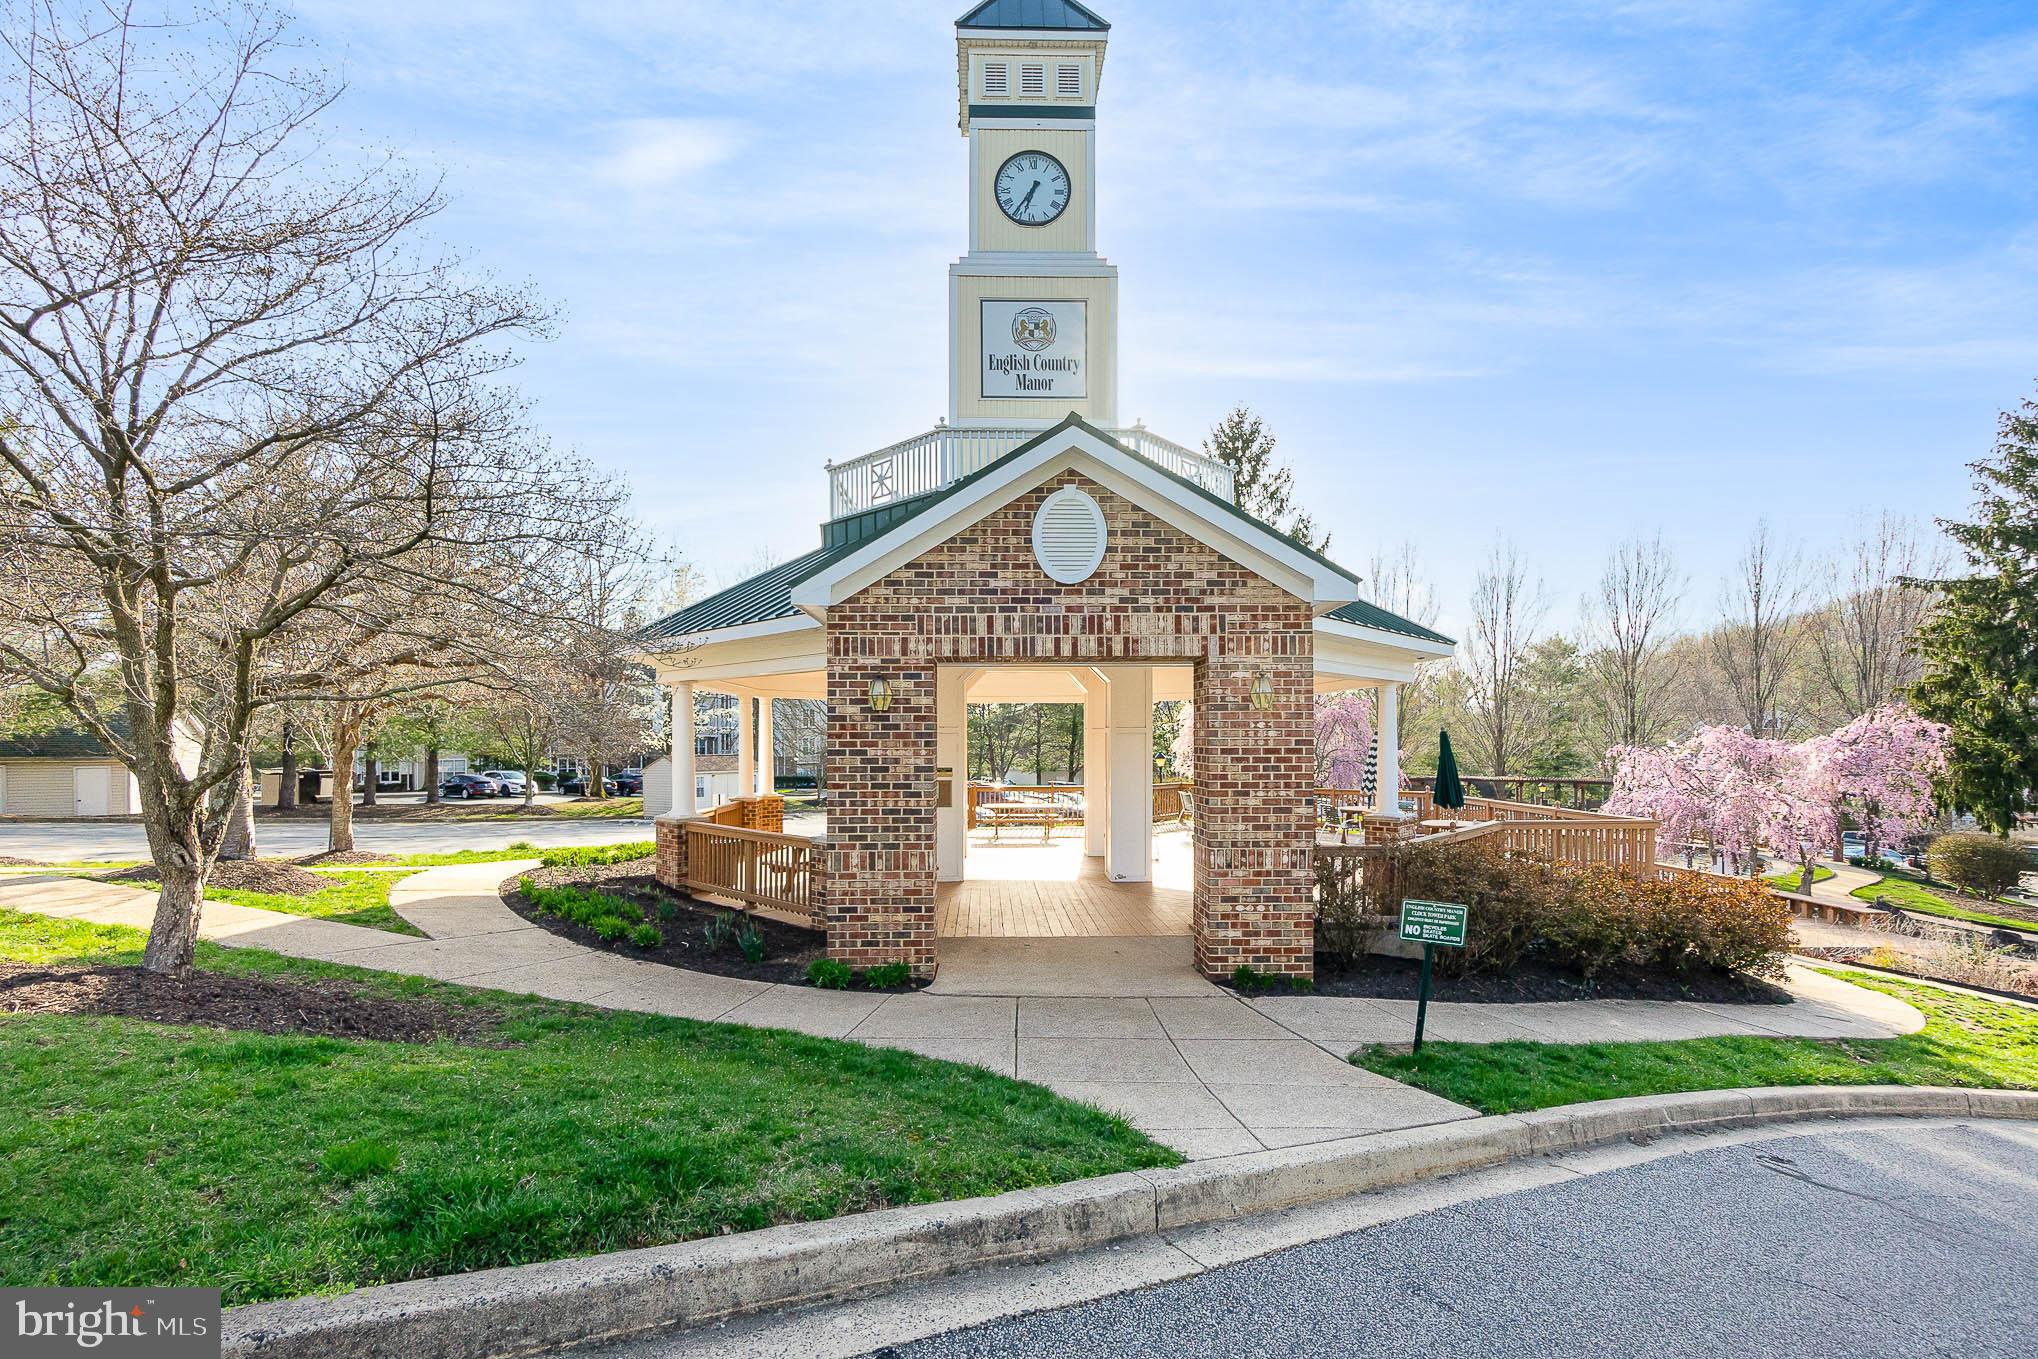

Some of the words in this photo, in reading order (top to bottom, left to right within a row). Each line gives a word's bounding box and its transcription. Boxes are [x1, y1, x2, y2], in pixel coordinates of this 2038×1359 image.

[988, 354, 1030, 375] English
[1033, 354, 1080, 375] Country
[1015, 373, 1054, 391] Manor
[1405, 924, 1421, 935] NO
